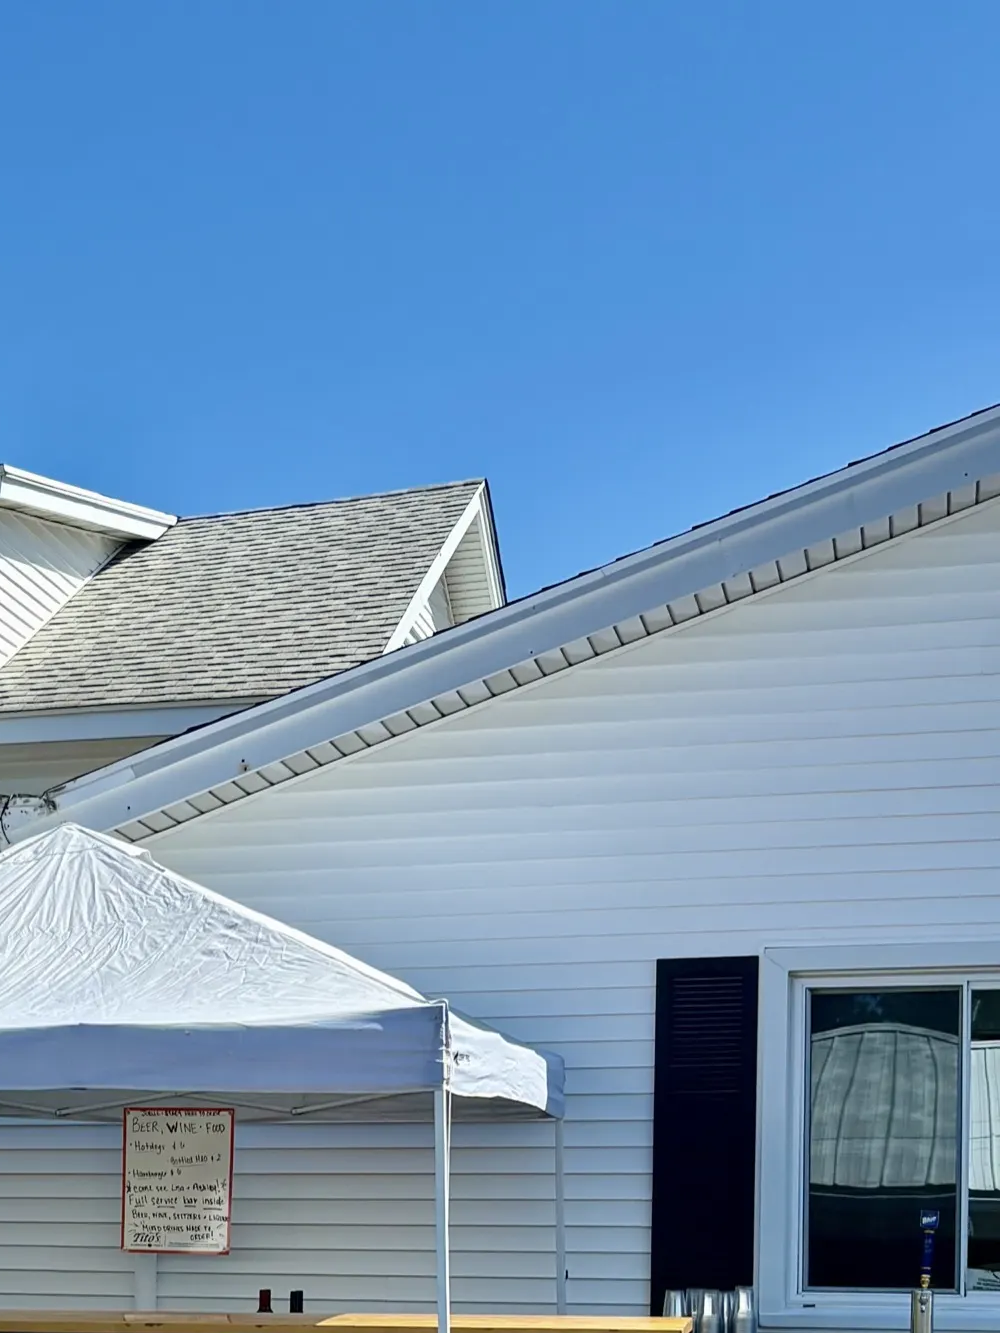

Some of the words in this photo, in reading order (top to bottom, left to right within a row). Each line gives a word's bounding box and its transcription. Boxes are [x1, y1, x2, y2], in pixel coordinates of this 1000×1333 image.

[205, 1122, 226, 1134] FOOD
[128, 1193, 148, 1206] Full
[151, 1196, 178, 1206] service
[182, 1195, 198, 1205] bar
[202, 1196, 225, 1206] inside
[133, 1232, 161, 1243] Tito's
